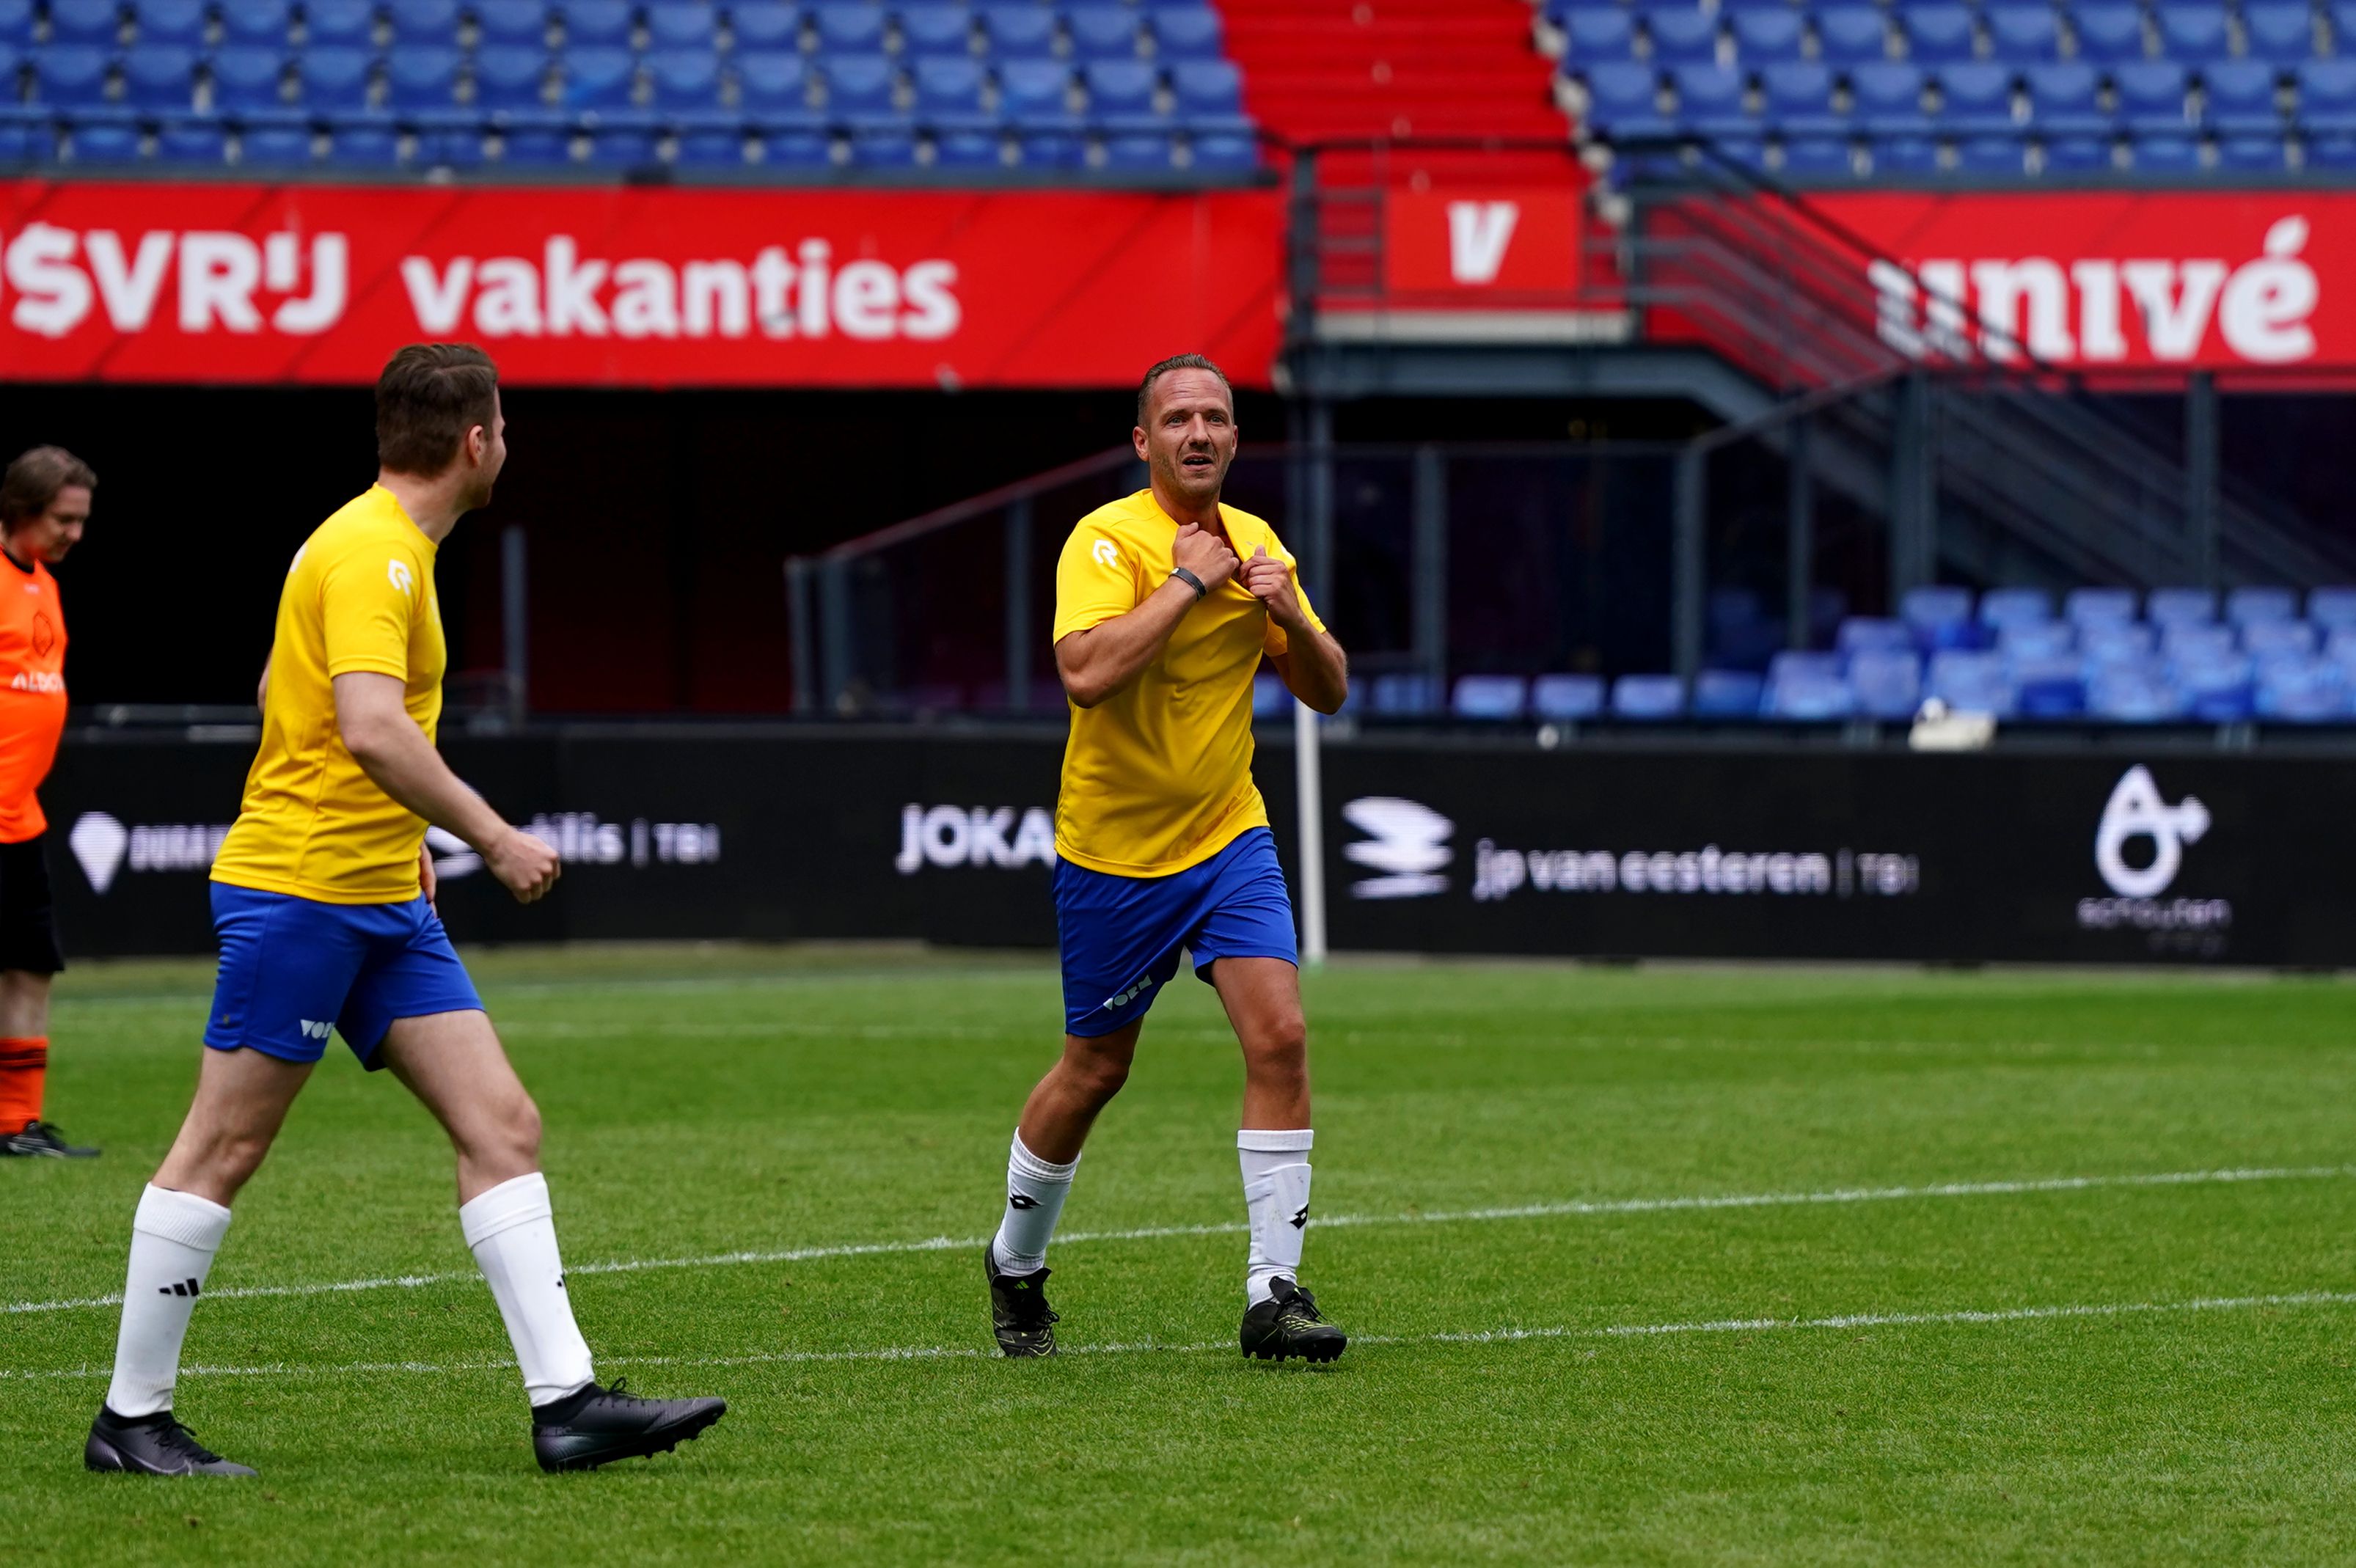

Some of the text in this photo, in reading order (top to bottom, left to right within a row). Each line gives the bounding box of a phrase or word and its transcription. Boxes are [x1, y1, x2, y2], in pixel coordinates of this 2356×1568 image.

[400, 235, 962, 340] vakanties
[1526, 849, 1615, 893] van
[1618, 843, 1832, 895] eesteren
